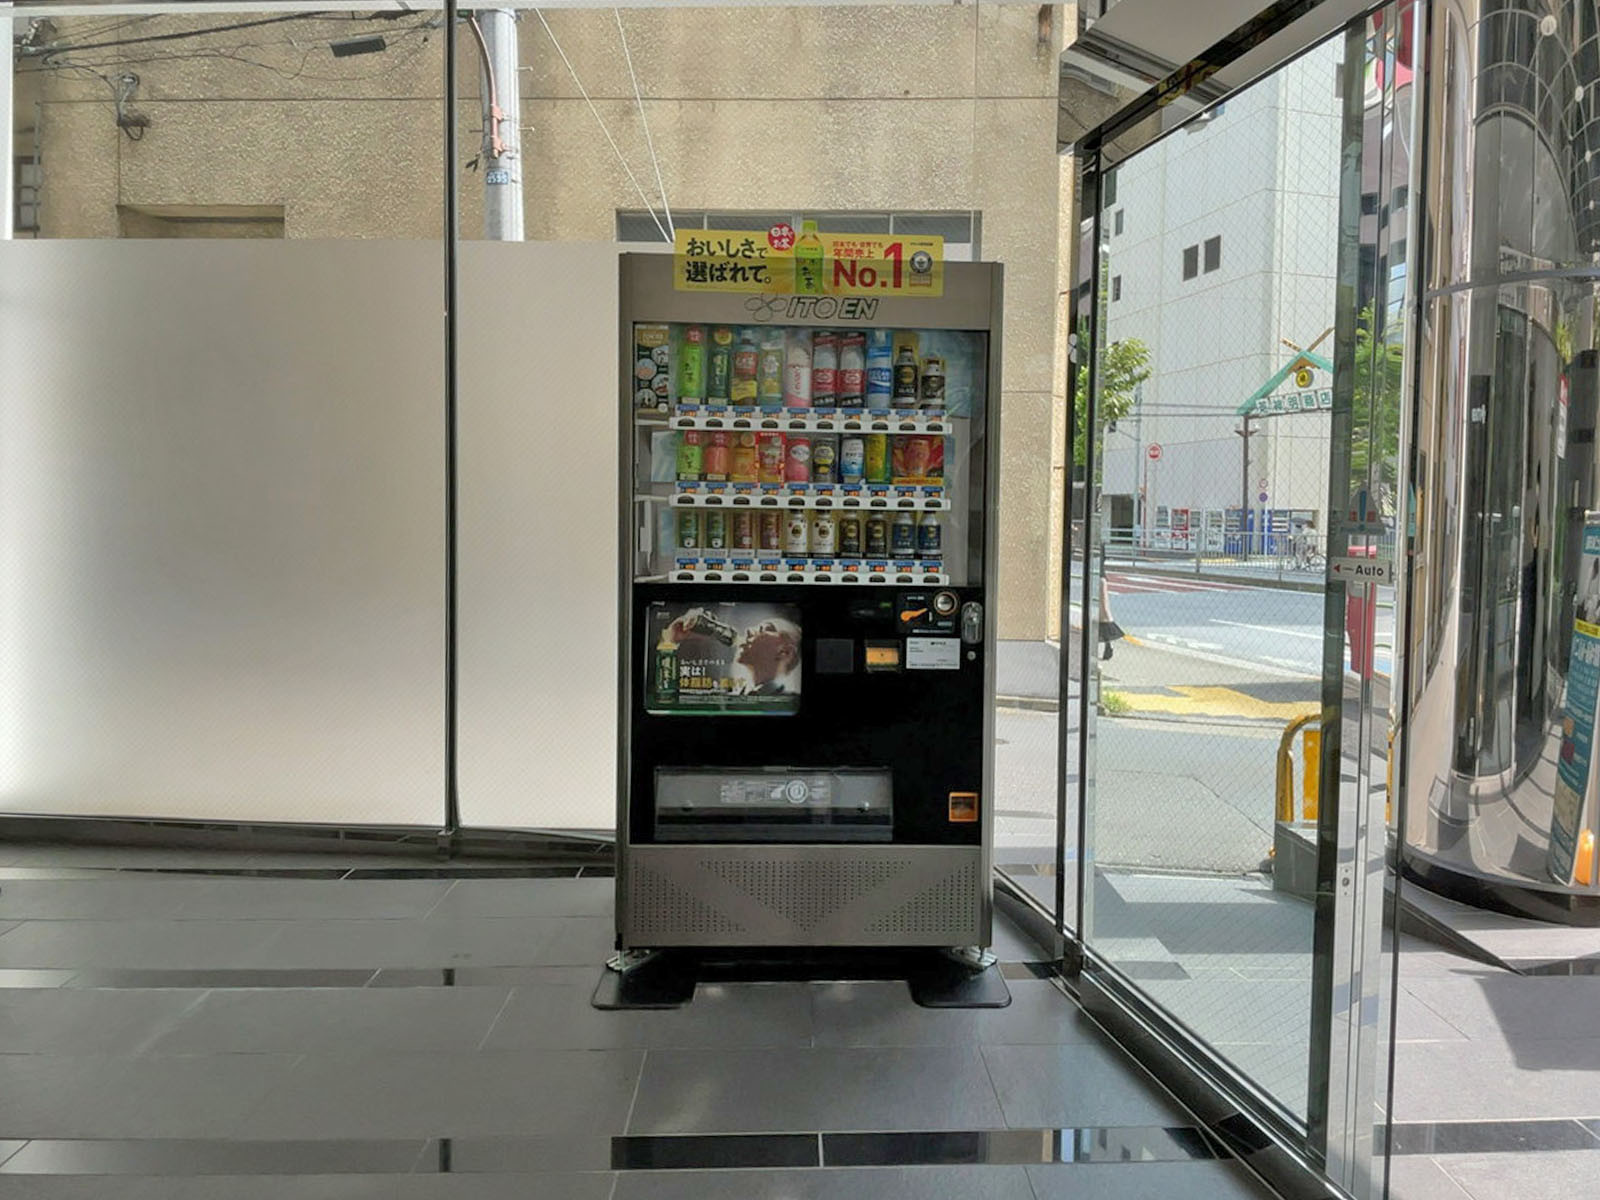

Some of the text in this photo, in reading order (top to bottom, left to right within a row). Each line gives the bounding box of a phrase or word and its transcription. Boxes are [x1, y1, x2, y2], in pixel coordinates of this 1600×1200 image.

[686, 261, 772, 284] 選ばれて。
[1355, 564, 1385, 577] Auto
